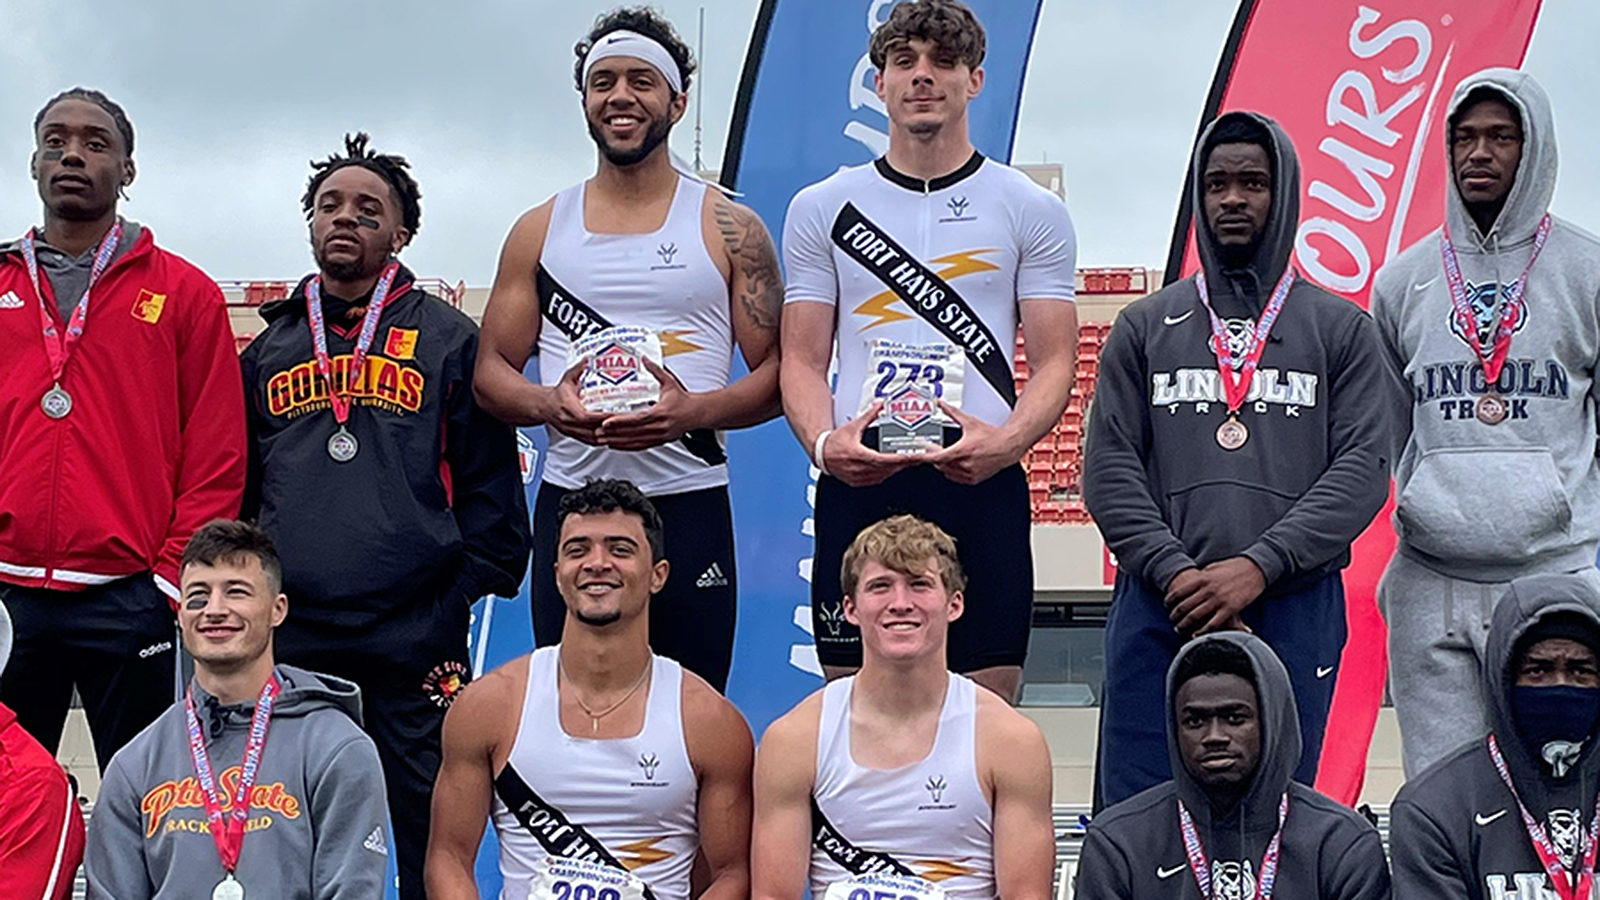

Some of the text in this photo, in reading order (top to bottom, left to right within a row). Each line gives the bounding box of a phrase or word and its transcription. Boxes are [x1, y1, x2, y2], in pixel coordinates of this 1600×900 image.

[548, 291, 603, 339] FORT
[842, 221, 996, 364] FORT HAYS STATE
[875, 360, 945, 398] 273
[1416, 358, 1569, 405] INCOLN
[219, 766, 300, 819] Sate
